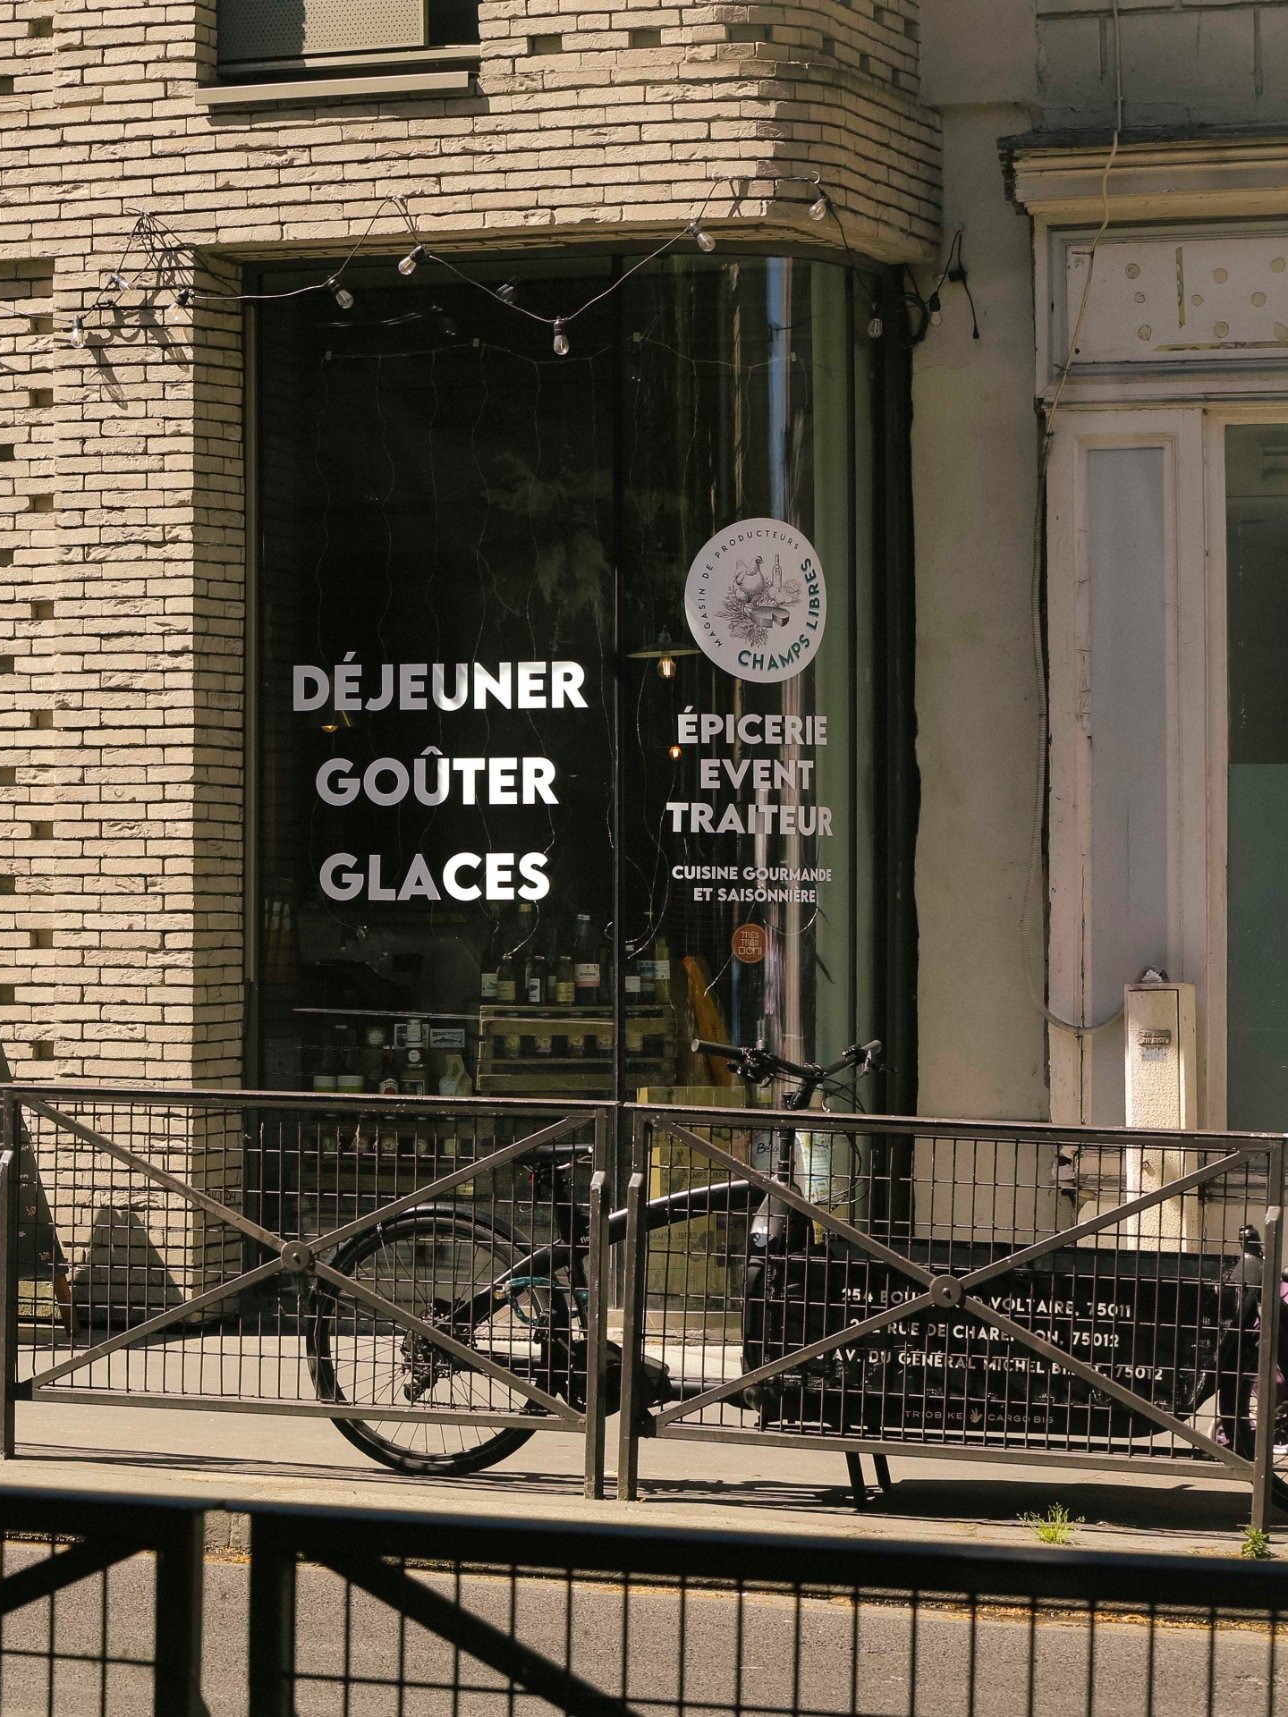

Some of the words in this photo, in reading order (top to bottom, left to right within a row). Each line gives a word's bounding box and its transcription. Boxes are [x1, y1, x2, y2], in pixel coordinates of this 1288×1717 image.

[714, 529, 799, 559] PRODUCTEURS
[702, 563, 714, 579] DE
[697, 588, 723, 648] MAGASIN
[737, 633, 811, 672] CHAMPS
[800, 557, 820, 631] LIBRES
[292, 651, 589, 712] DÉJEUNER
[677, 705, 828, 746] ÉPICERIE
[315, 745, 559, 807] GOÛTER
[700, 758, 814, 790] EVENT
[665, 802, 833, 837] TRAITEUR
[319, 851, 551, 901] GLACES
[671, 865, 738, 881] CUISINE
[742, 866, 832, 882] GOURMANDE
[693, 887, 713, 902] ET
[717, 884, 816, 903] SAISONNIÈRE
[841, 1288, 874, 1303] 254
[1086, 1302, 1131, 1318] 75011
[887, 1321, 920, 1336] RUE
[927, 1323, 947, 1338] DE
[1072, 1331, 1119, 1348] 75012
[832, 1348, 861, 1362] AV.
[868, 1350, 892, 1365] DU
[983, 1358, 1045, 1375] MICHEL
[1115, 1365, 1163, 1381] 75012
